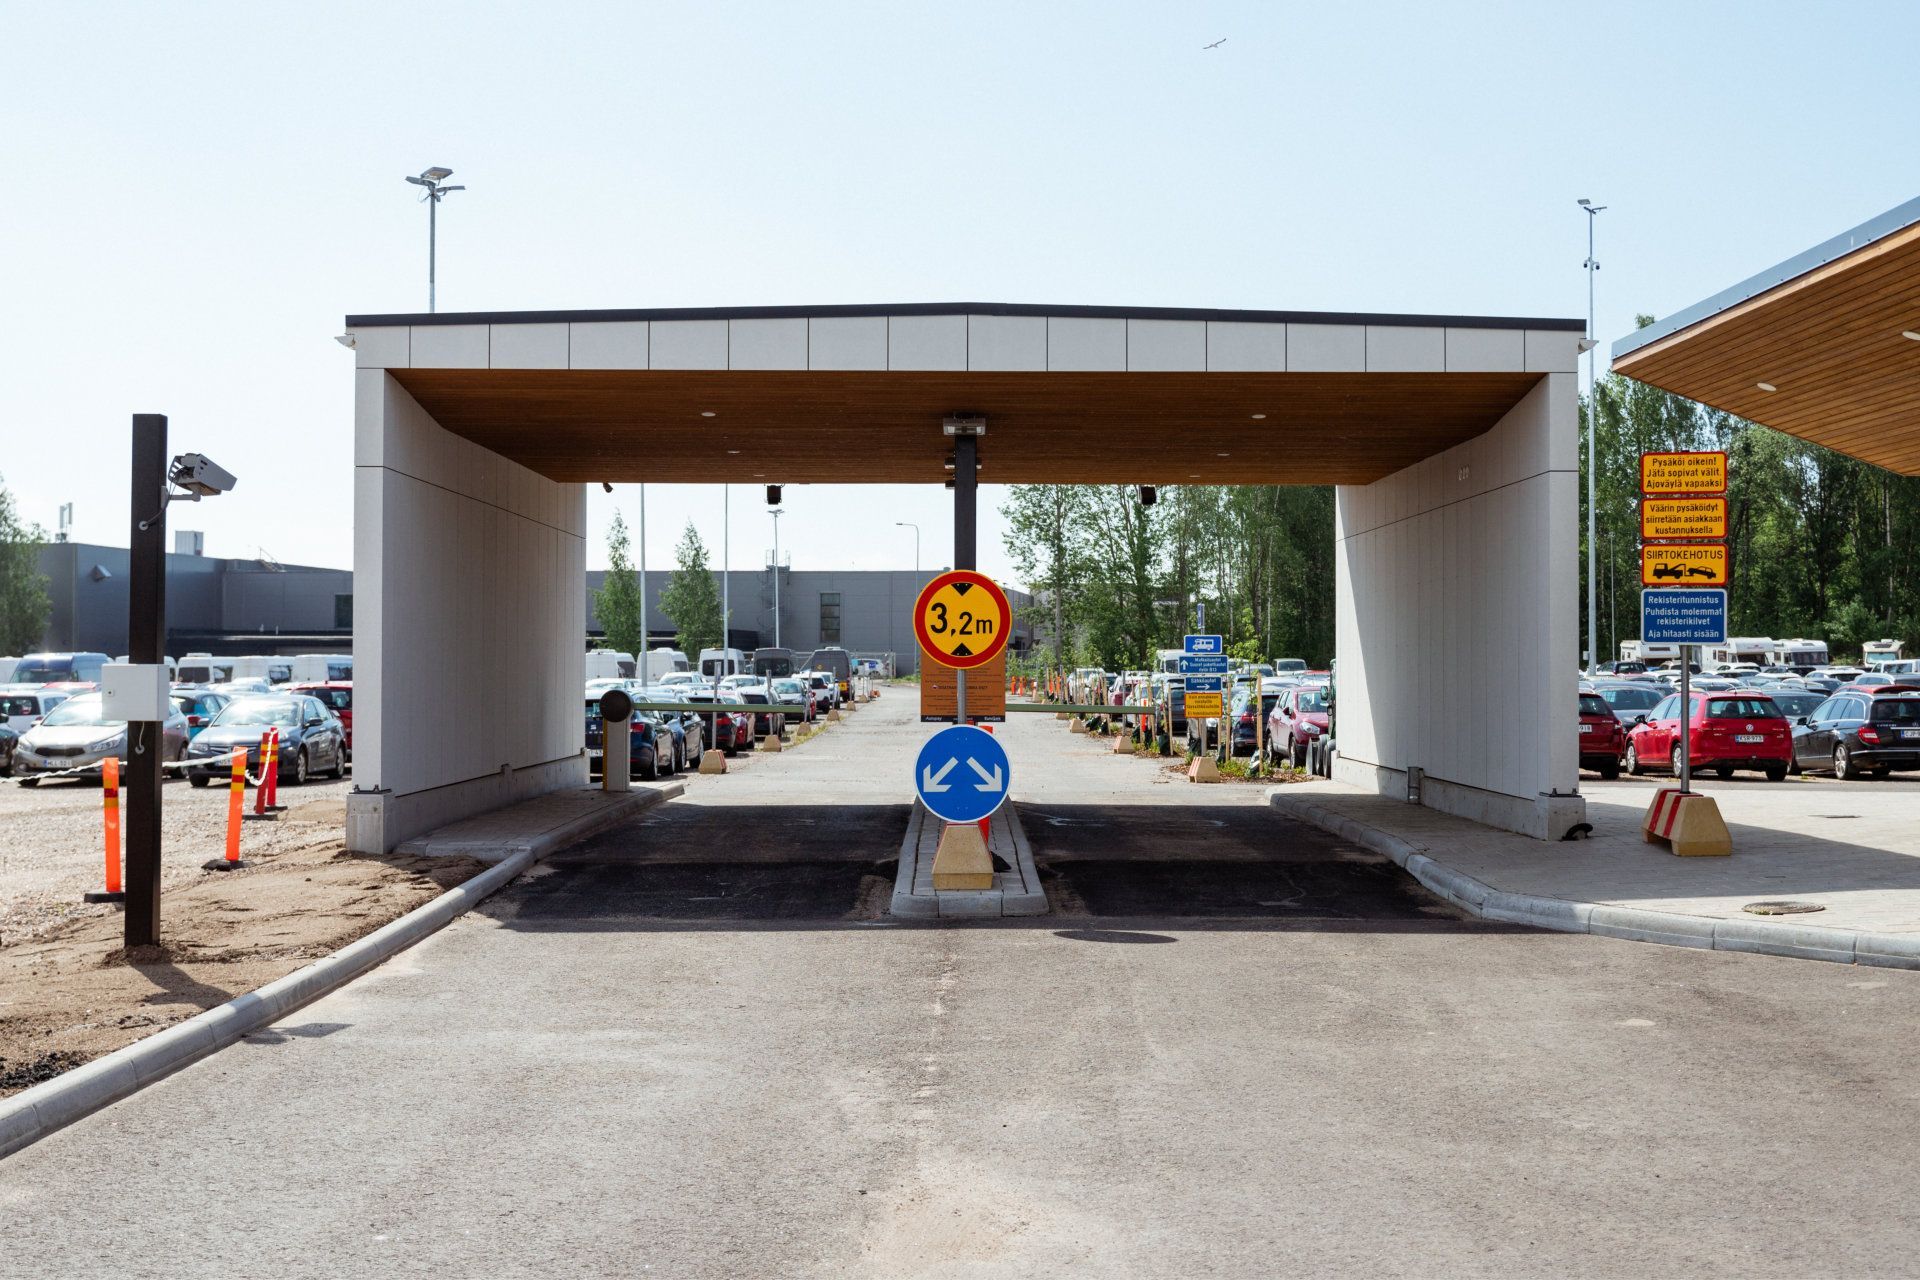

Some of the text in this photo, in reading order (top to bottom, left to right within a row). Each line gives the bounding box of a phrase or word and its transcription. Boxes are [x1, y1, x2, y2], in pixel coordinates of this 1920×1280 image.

[1652, 457, 1717, 467] Pysäköi oikein!
[1646, 468, 1665, 478] Jätä
[1667, 468, 1699, 478] sopivat
[1646, 479, 1722, 489] Ajoväylä vapaaksi
[1649, 503, 1718, 513] Väärin pysäköidyt
[1645, 515, 1722, 524] siirretään asiakkaan
[1655, 526, 1713, 535] kustannuksella
[1646, 550, 1723, 560] SIIRTOKEHOTUS
[1648, 596, 1719, 604] Rekisteritunnistus
[1645, 607, 1722, 616] Puhdista molemmat
[1656, 616, 1710, 625] rekisterikilvet
[1648, 629, 1719, 639] Aja hitaasti sisään
